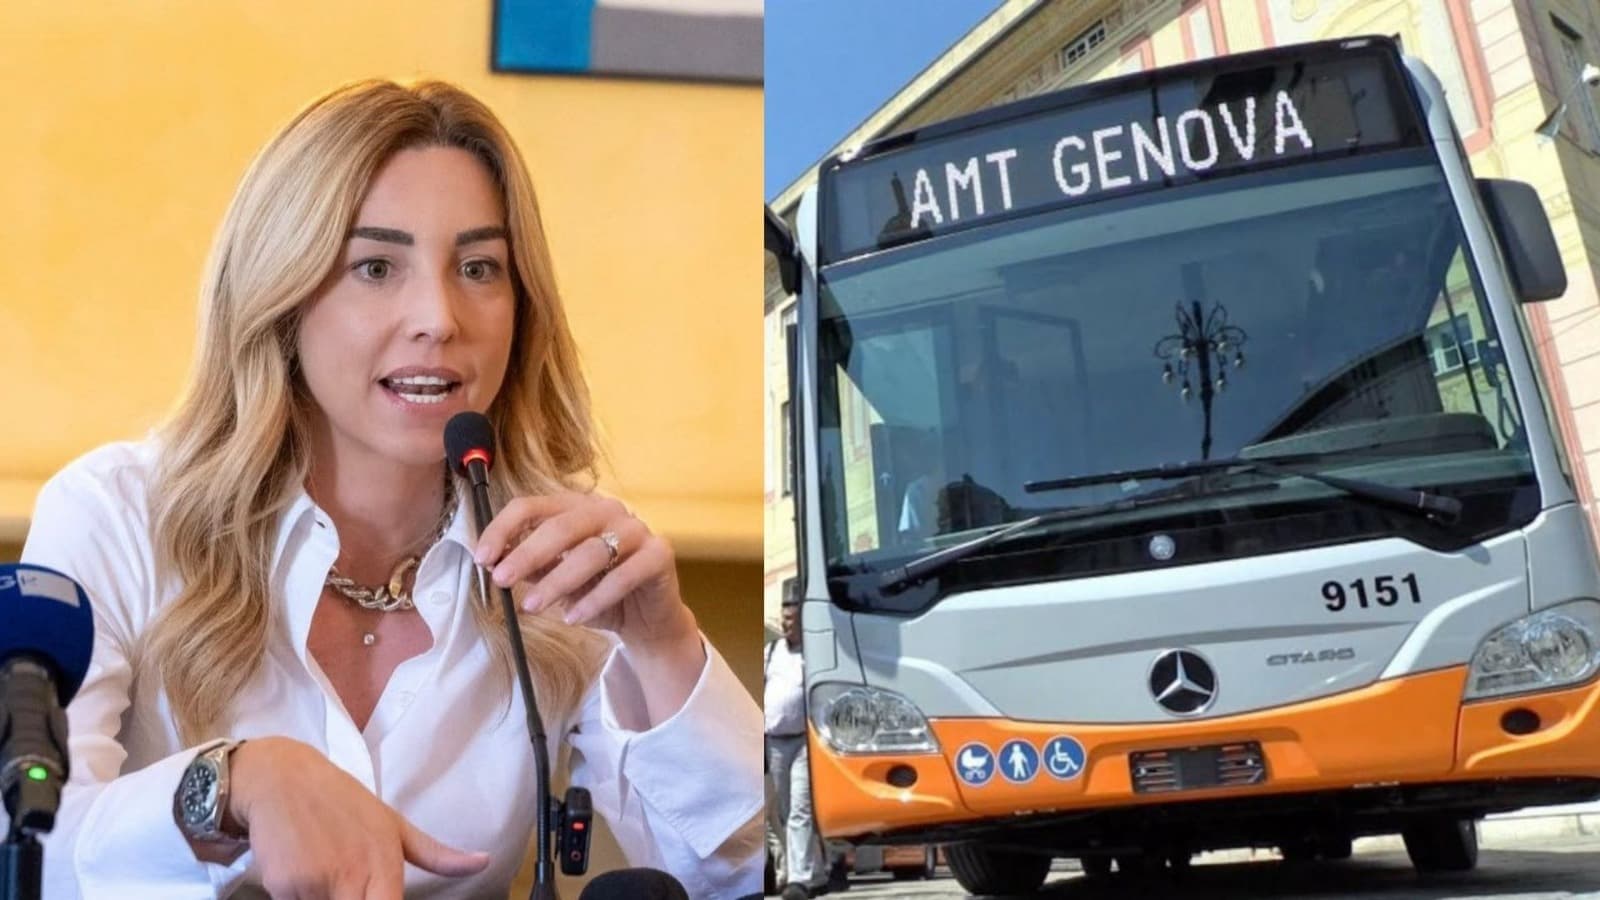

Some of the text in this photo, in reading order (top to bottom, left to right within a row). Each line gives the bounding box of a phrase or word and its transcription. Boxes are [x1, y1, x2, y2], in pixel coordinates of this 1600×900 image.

[910, 90, 1313, 228] AMT GENOVA
[1321, 572, 1422, 612] 9151
[1266, 647, 1356, 667] CITARO
